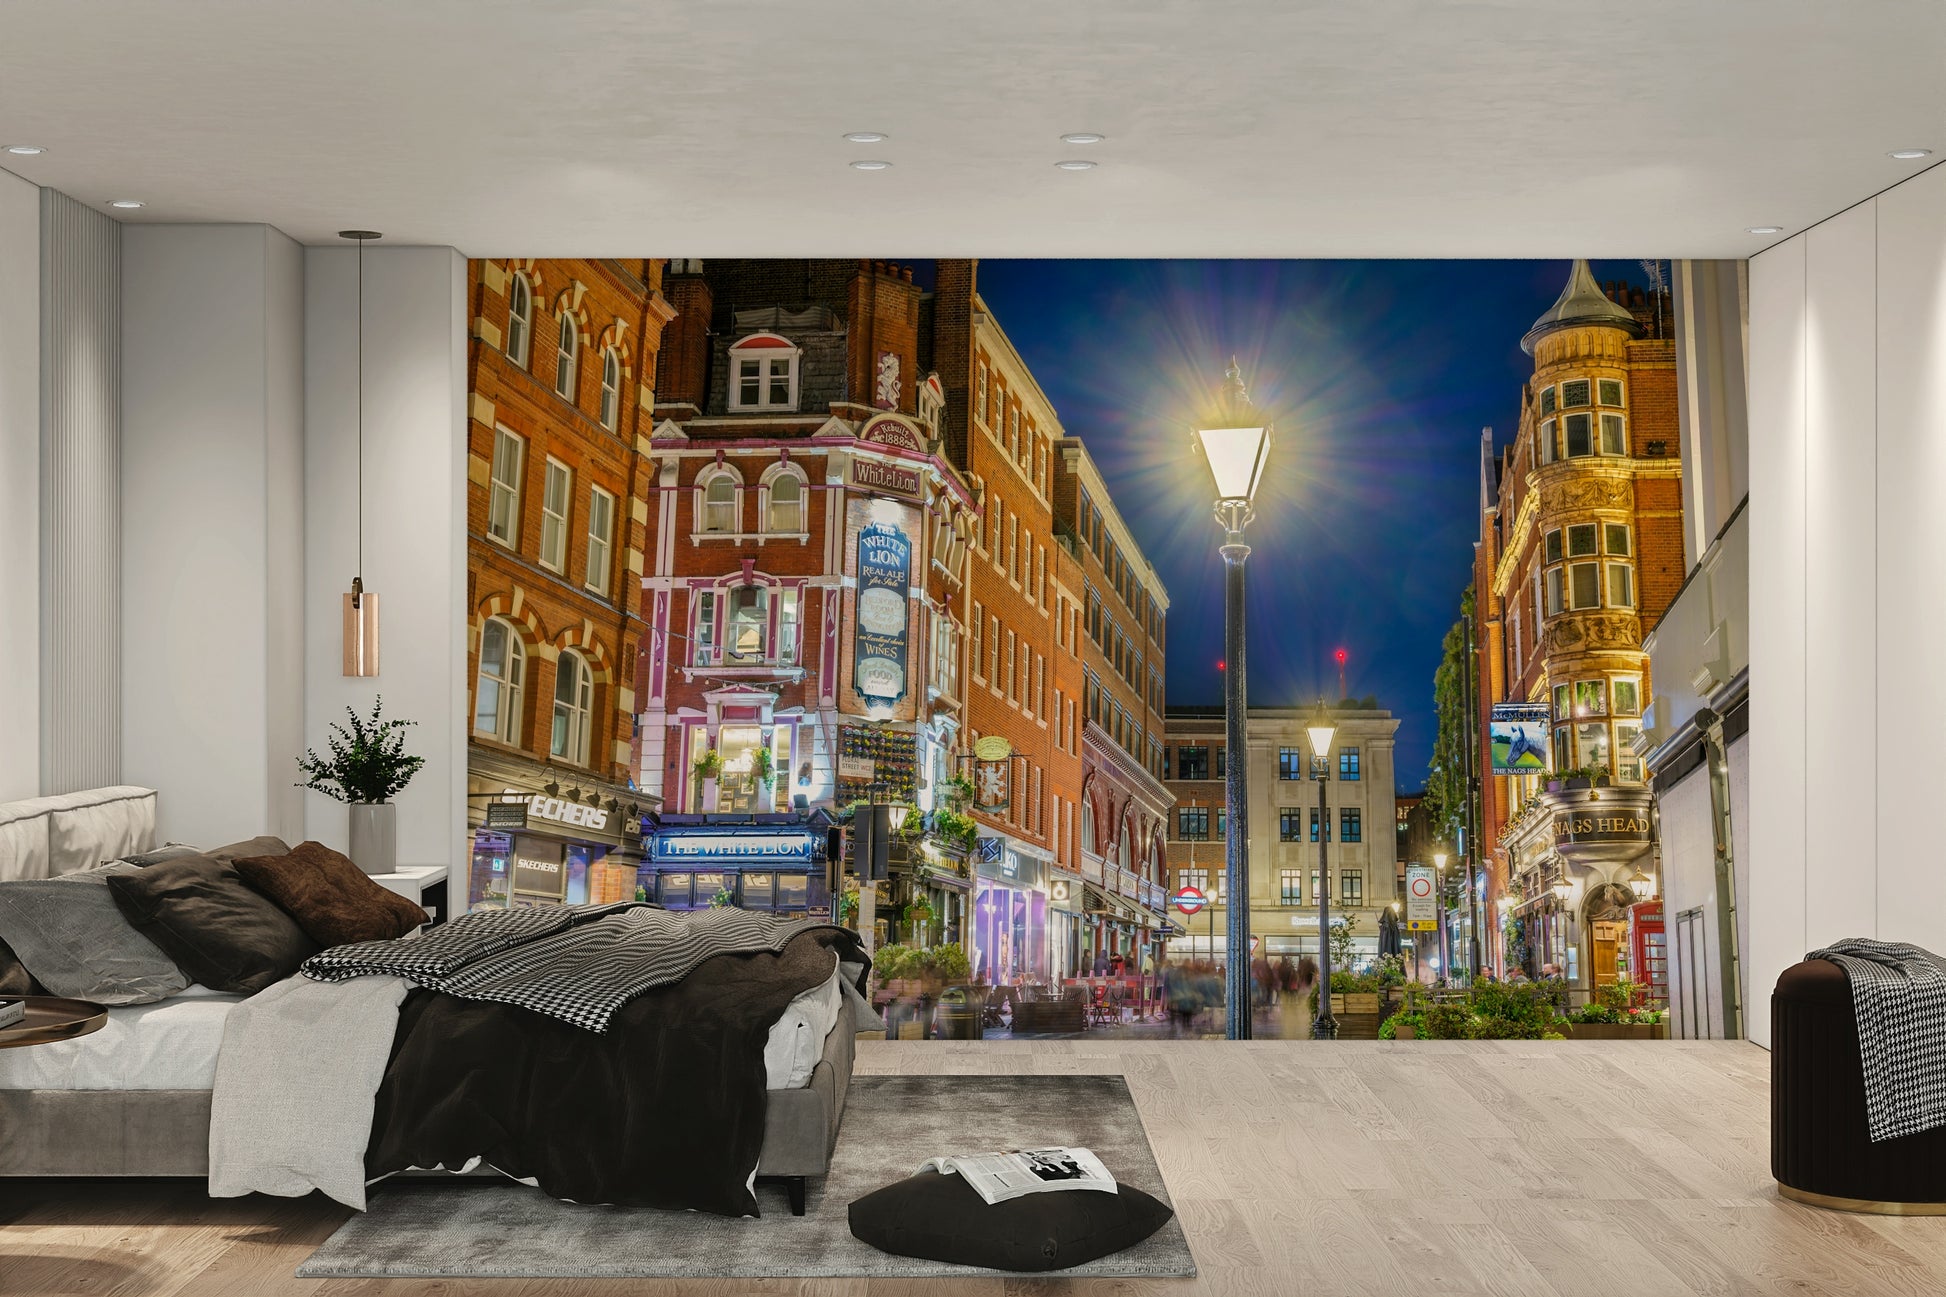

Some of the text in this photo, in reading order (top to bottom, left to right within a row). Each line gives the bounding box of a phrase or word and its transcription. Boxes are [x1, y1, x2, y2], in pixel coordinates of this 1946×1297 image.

[880, 424, 909, 438] Rebuilt
[885, 433, 905, 445] 1888
[876, 524, 896, 536] THE
[862, 535, 908, 557] WHITE
[869, 549, 900, 567] LION
[863, 565, 905, 582] REAL ALE
[868, 576, 881, 586] for
[865, 641, 898, 658] WINES
[868, 669, 893, 681] FOOD
[1597, 817, 1650, 834] HEAD
[663, 841, 806, 856] THE WHITE LION
[517, 858, 560, 873] SKECHERS
